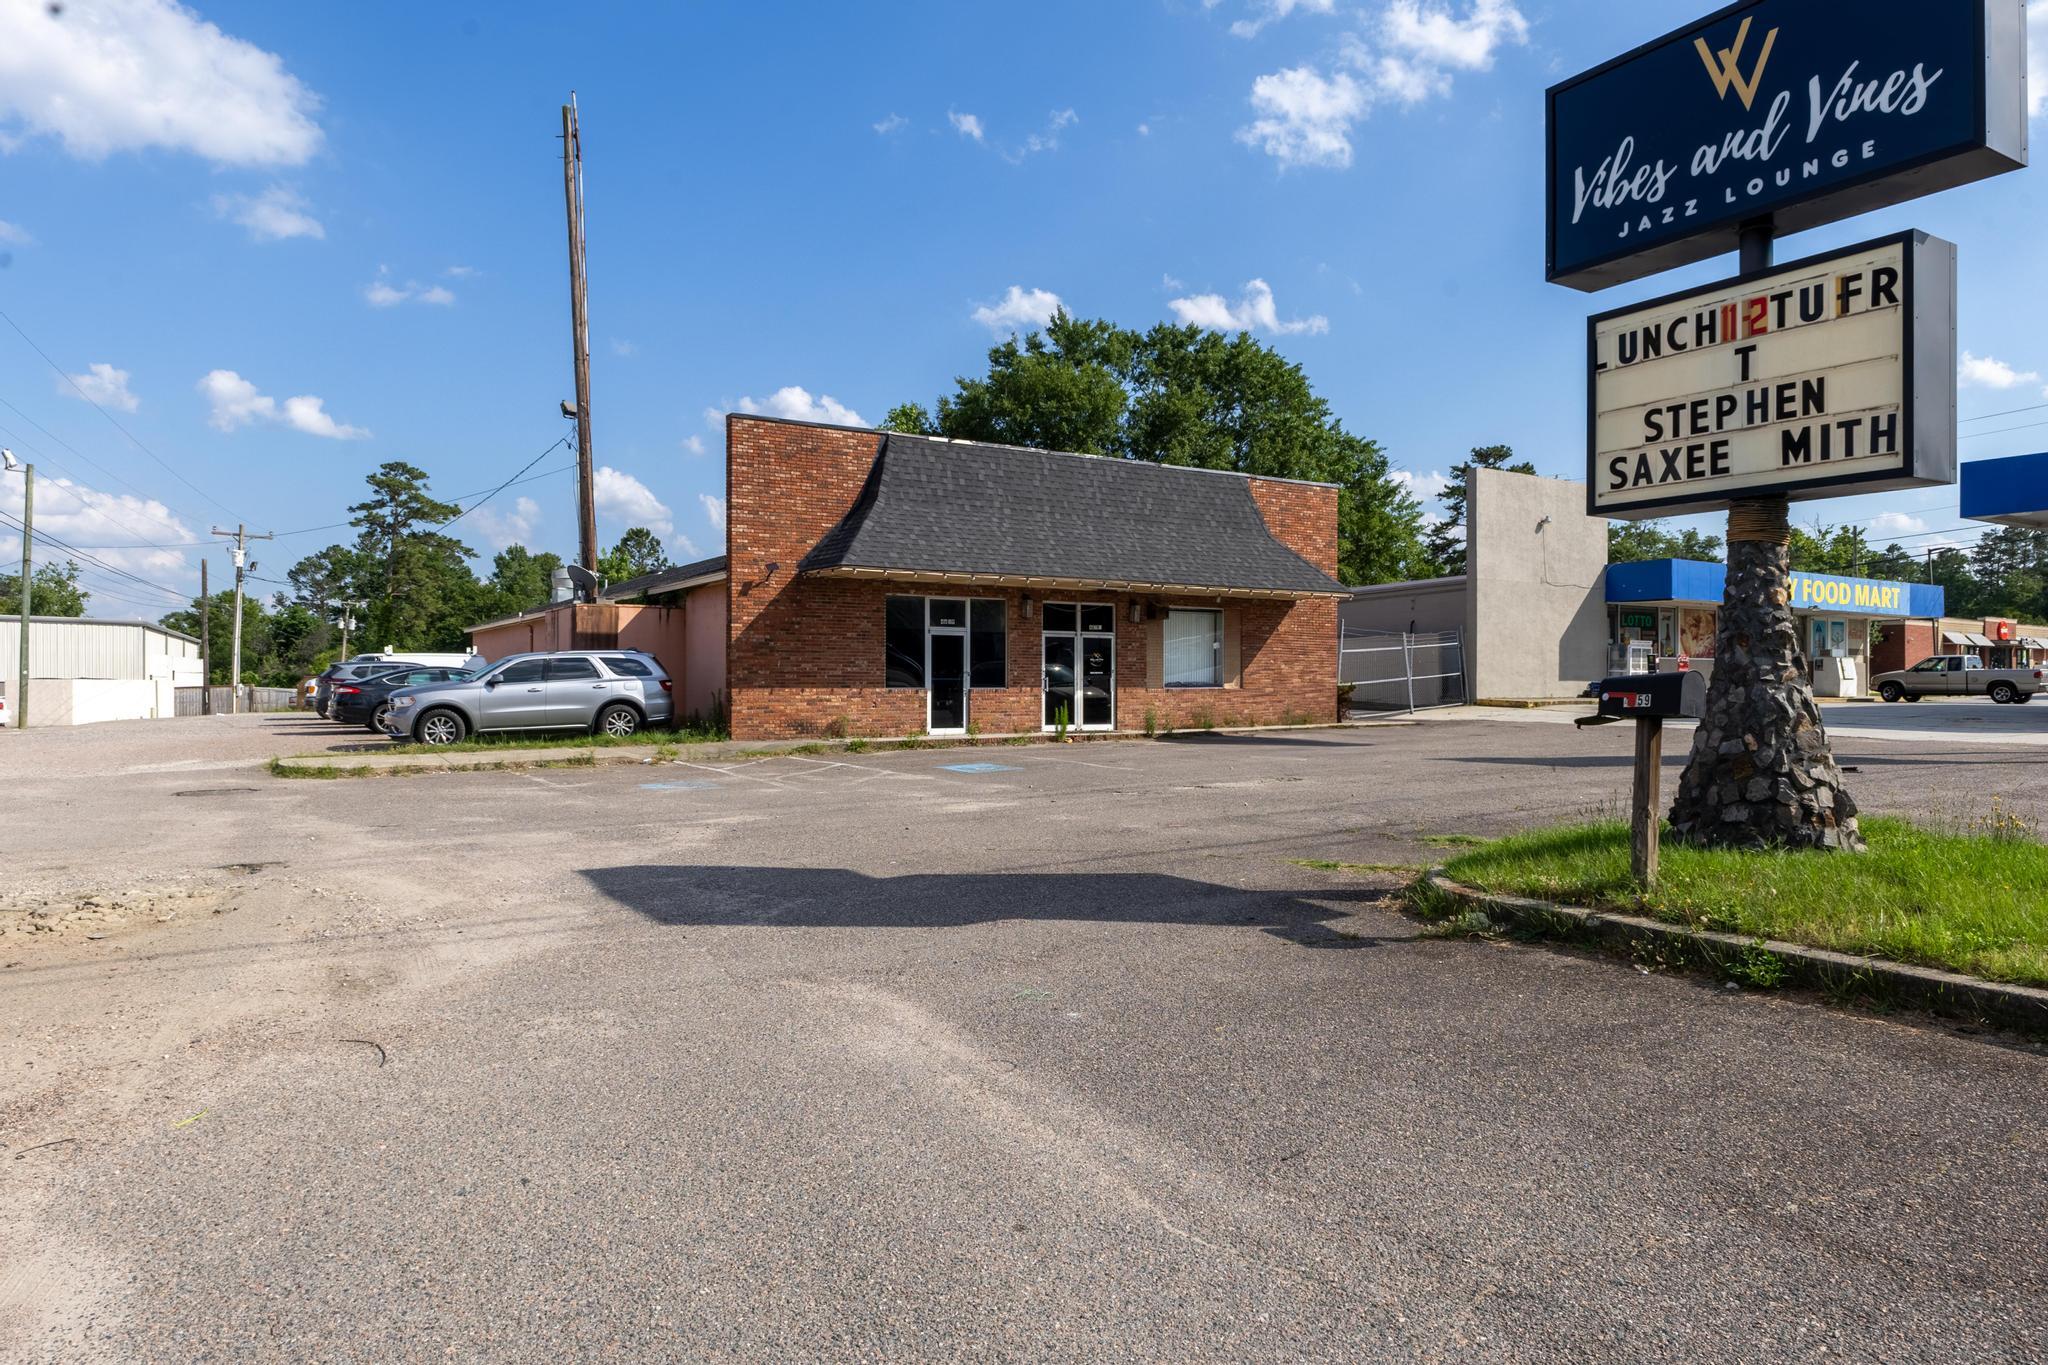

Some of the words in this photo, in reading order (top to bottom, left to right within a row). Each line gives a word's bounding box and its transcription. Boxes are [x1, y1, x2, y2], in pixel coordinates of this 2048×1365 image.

[1571, 135, 1678, 225] Vibes
[1690, 90, 1791, 177] and
[1805, 59, 1944, 144] Vines
[1617, 198, 1698, 238] JAZZ
[1724, 139, 1875, 204] LOUNGE
[1734, 343, 1757, 382] T
[1643, 376, 1825, 443] STEPHEN
[1609, 439, 1731, 490] SAXEE
[1781, 412, 1898, 466] MITH
[1621, 614, 1652, 627] LOTTO
[1802, 578, 1852, 605] FOOD
[1854, 584, 1901, 609] MART
